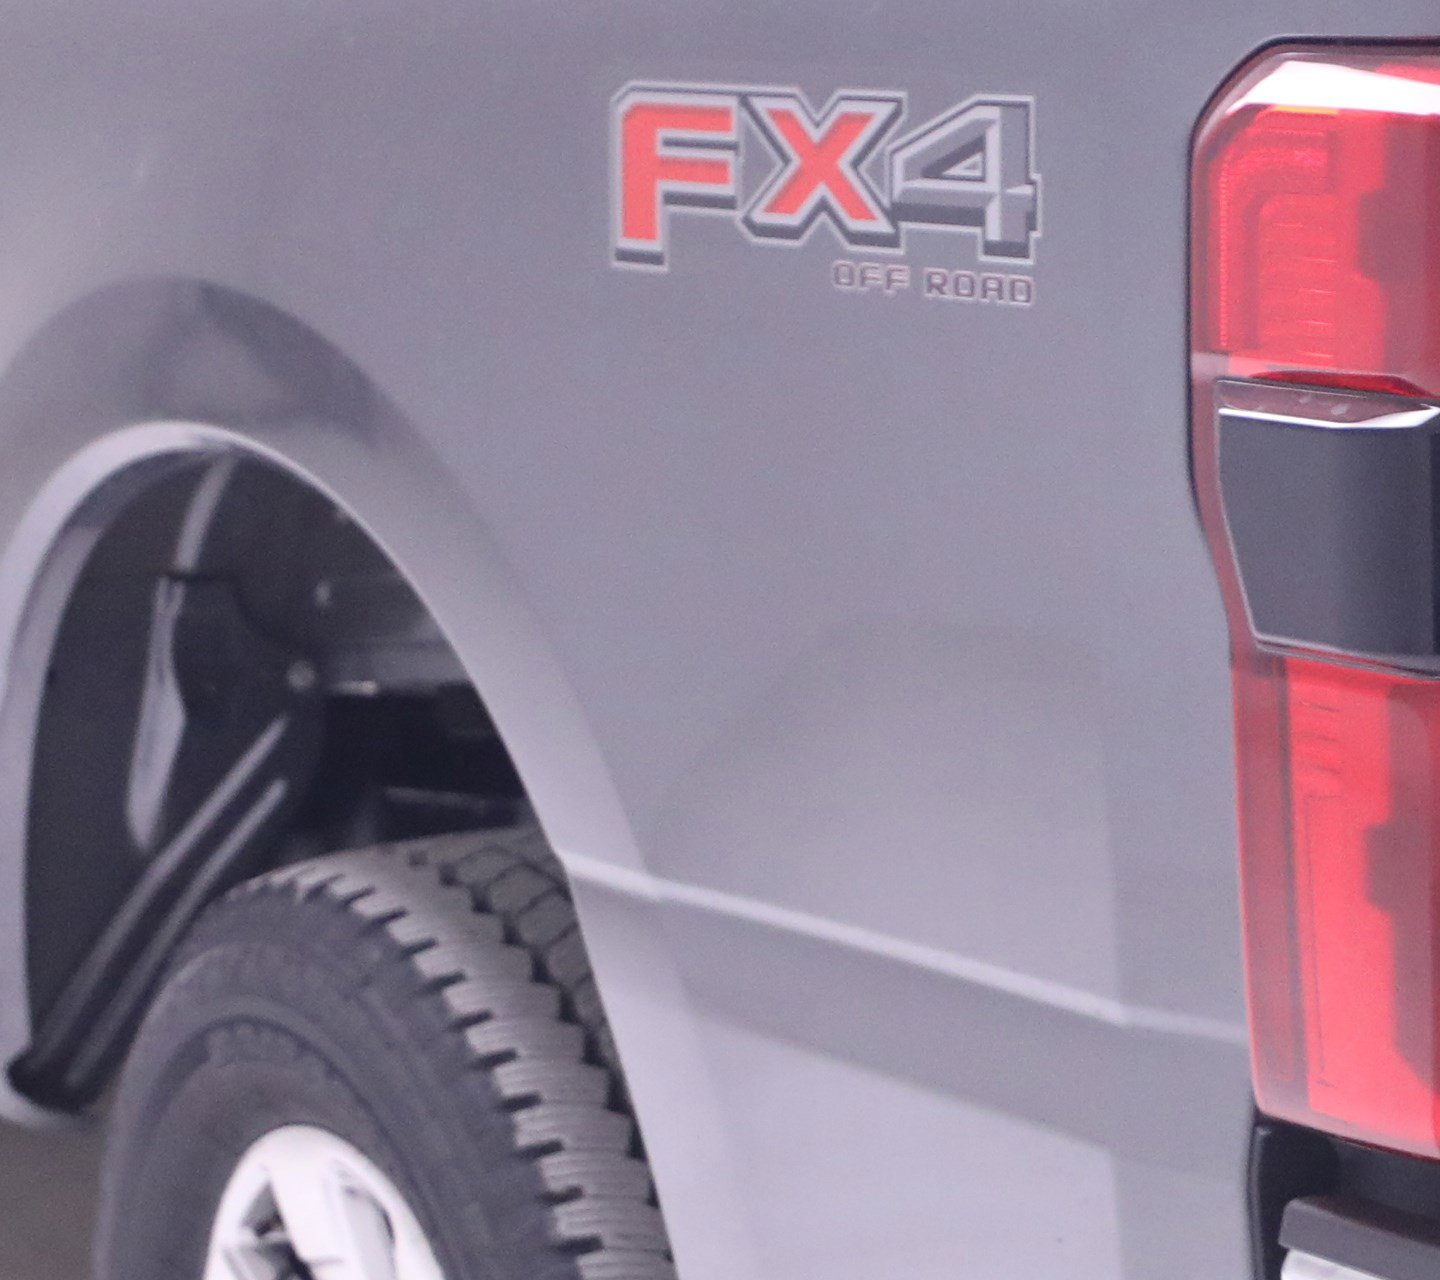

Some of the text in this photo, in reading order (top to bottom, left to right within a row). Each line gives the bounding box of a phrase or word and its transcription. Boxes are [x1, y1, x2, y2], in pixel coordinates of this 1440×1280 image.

[610, 80, 1042, 271] FX4
[833, 259, 1035, 307] OFF ROAD
